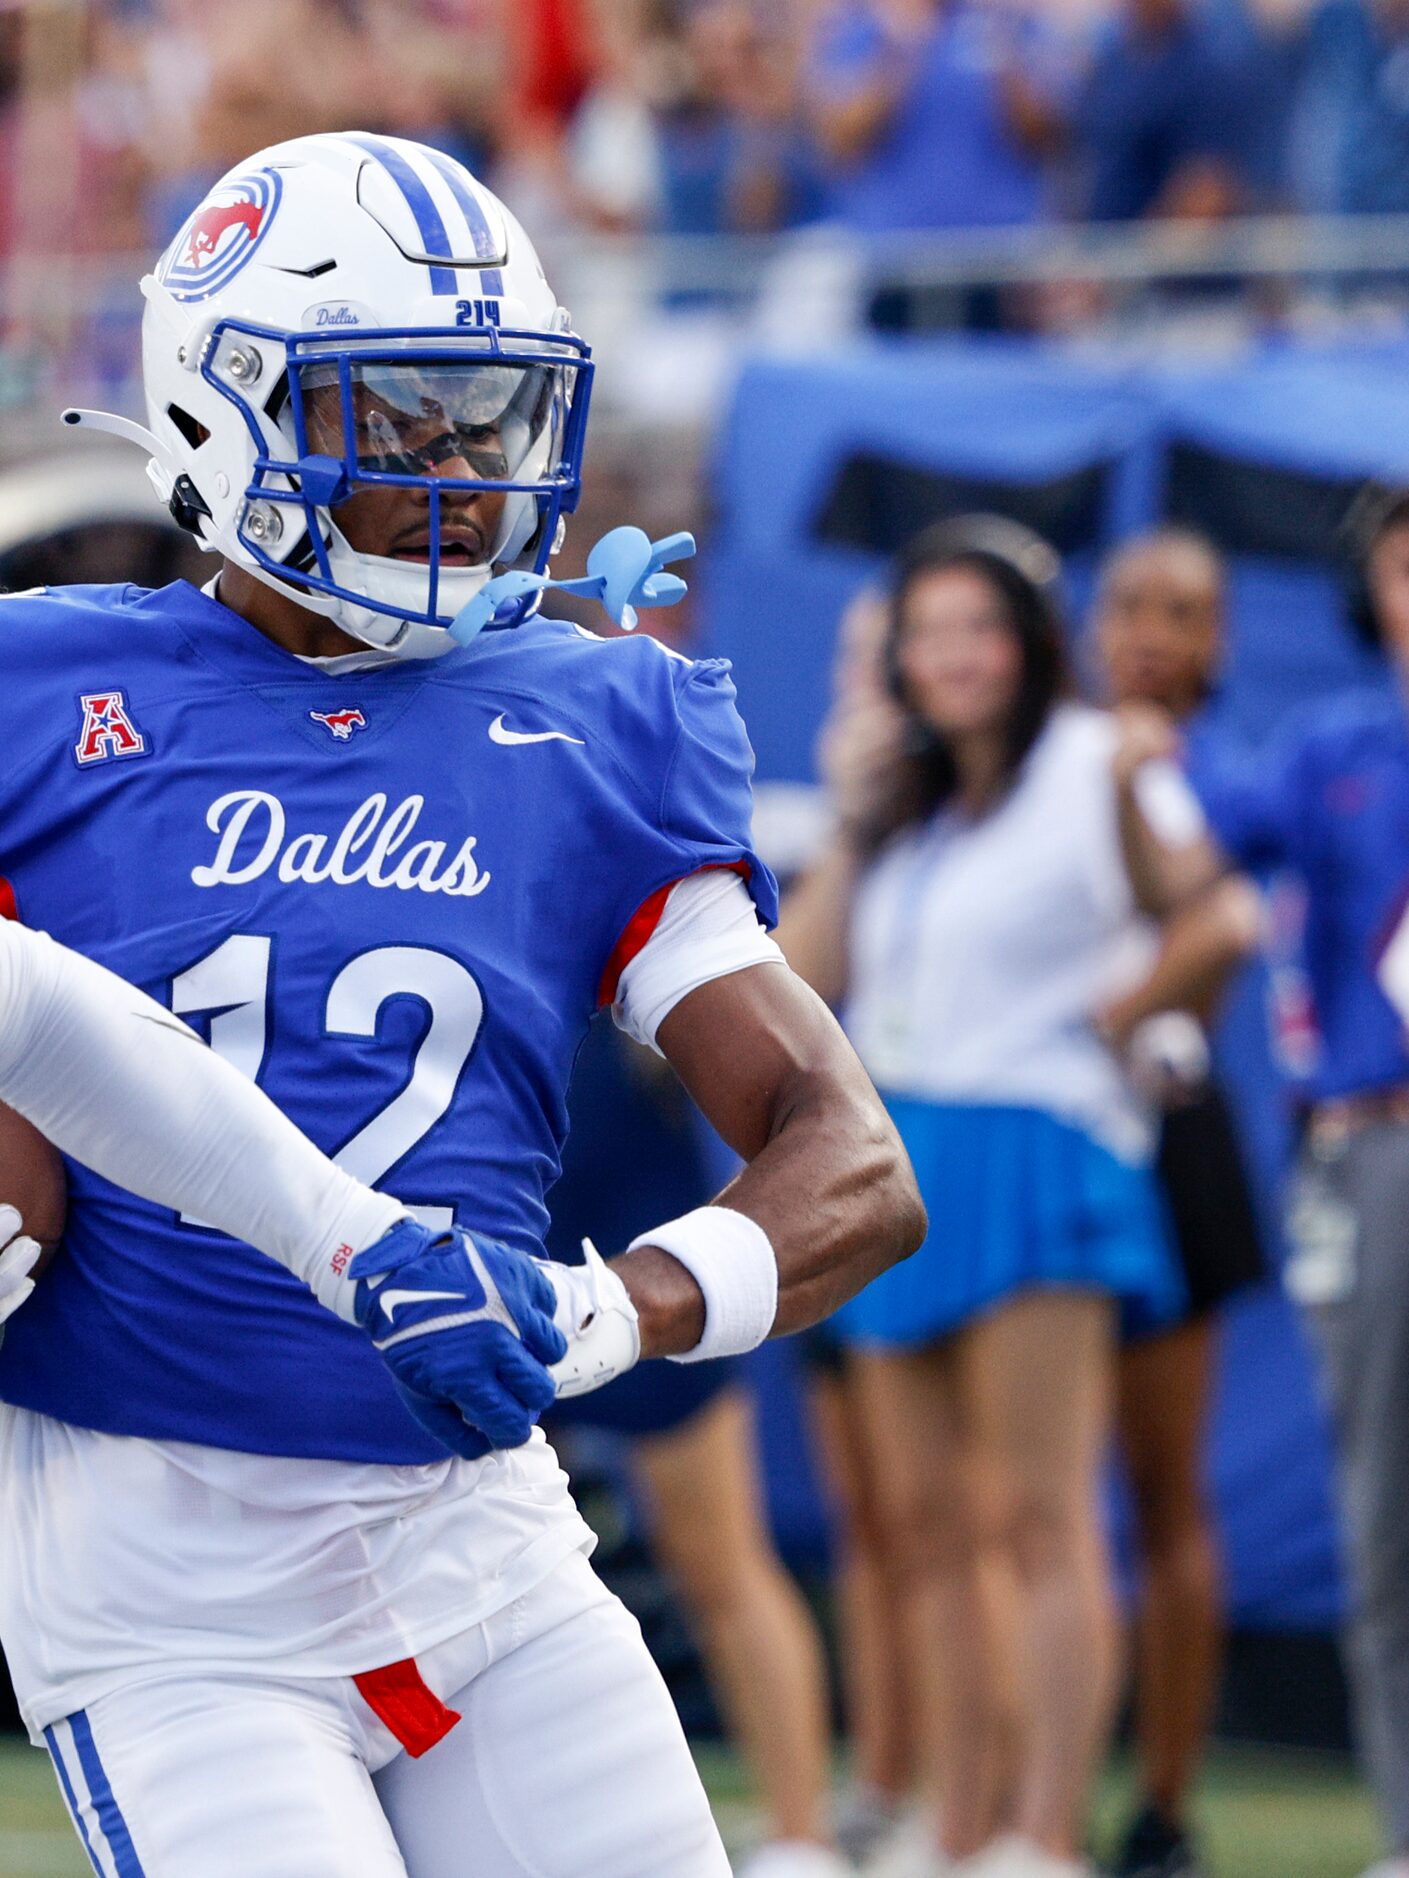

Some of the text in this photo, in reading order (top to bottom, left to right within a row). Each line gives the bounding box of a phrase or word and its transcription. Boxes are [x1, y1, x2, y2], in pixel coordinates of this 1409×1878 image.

[316, 306, 360, 327] Dallas
[456, 299, 501, 327] 214
[191, 789, 491, 897] Dallas
[172, 934, 484, 1229] 12
[329, 1242, 353, 1276] RSF
